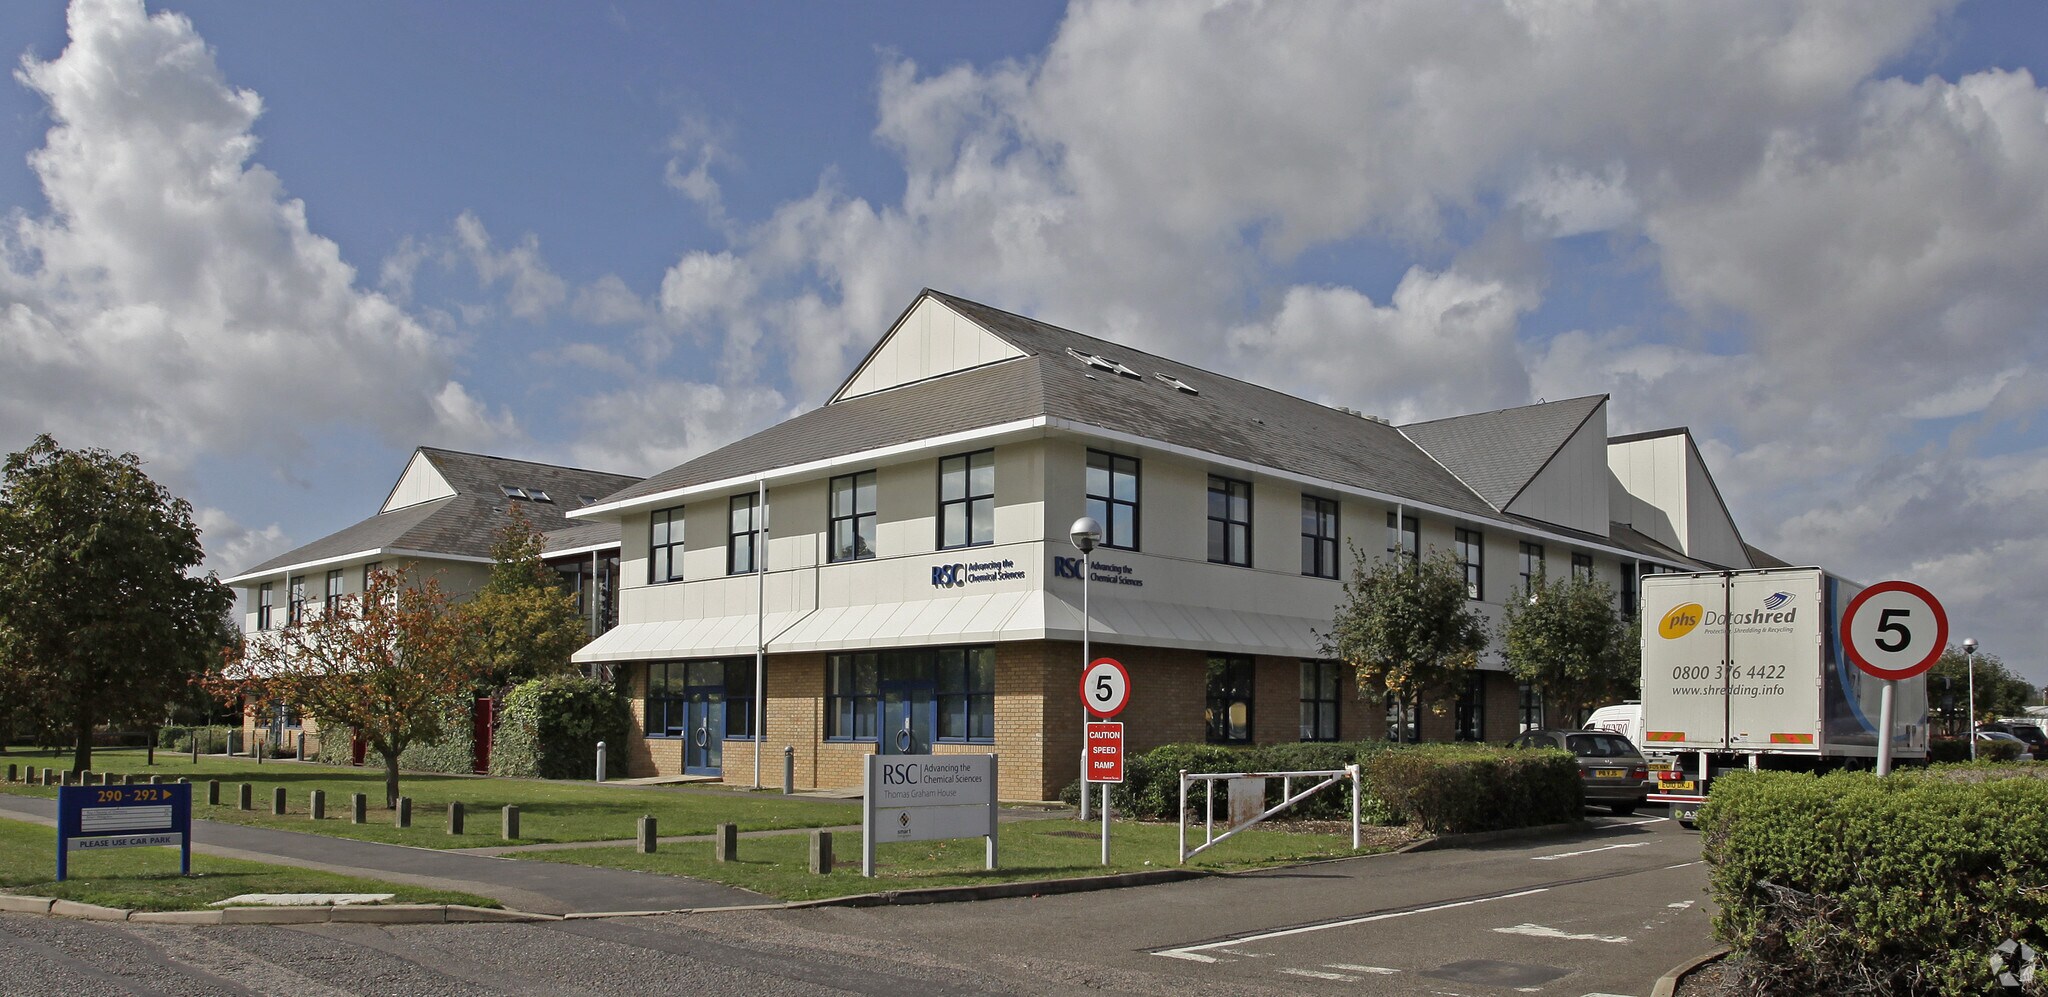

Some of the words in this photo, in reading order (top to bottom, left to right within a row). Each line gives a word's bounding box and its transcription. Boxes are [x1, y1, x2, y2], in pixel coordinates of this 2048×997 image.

[968, 559, 1001, 572] Advancing
[1002, 558, 1014, 569] the
[1054, 556, 1085, 580] RSC
[1090, 561, 1122, 573] Advancing
[1122, 564, 1133, 574] the
[931, 564, 964, 588] RSC
[968, 571, 997, 583] Chemical
[997, 569, 1026, 581] Sciences
[1090, 572, 1118, 584] Chemical
[1118, 575, 1143, 587] Sciences
[1669, 612, 1696, 630] phs
[1704, 607, 1797, 626] Datashred
[1734, 627, 1761, 635] Shredding
[1767, 626, 1794, 634] Recycling
[1874, 608, 1912, 652] 5
[1672, 665, 1709, 680] 0800
[1714, 665, 1741, 680] 376
[1746, 664, 1786, 679] 4422
[1095, 675, 1113, 702] 5
[1672, 683, 1784, 698] www.shredding.info
[1089, 731, 1120, 739] CAUTION
[1092, 746, 1117, 754] SPEED
[924, 763, 959, 774] Advancing
[960, 763, 971, 772] the
[1094, 761, 1115, 769] RAMP
[883, 763, 918, 785] RSC
[923, 774, 954, 784] Chemical
[956, 774, 982, 783] Sciences
[98, 790, 122, 802] 290
[134, 789, 157, 801] 292
[884, 790, 910, 799] Thomas
[911, 789, 936, 798] Graham
[937, 788, 957, 797] House
[79, 840, 109, 848] PLEASE
[112, 838, 127, 846] USE
[129, 837, 147, 845] CAR
[150, 836, 171, 844] PARK
